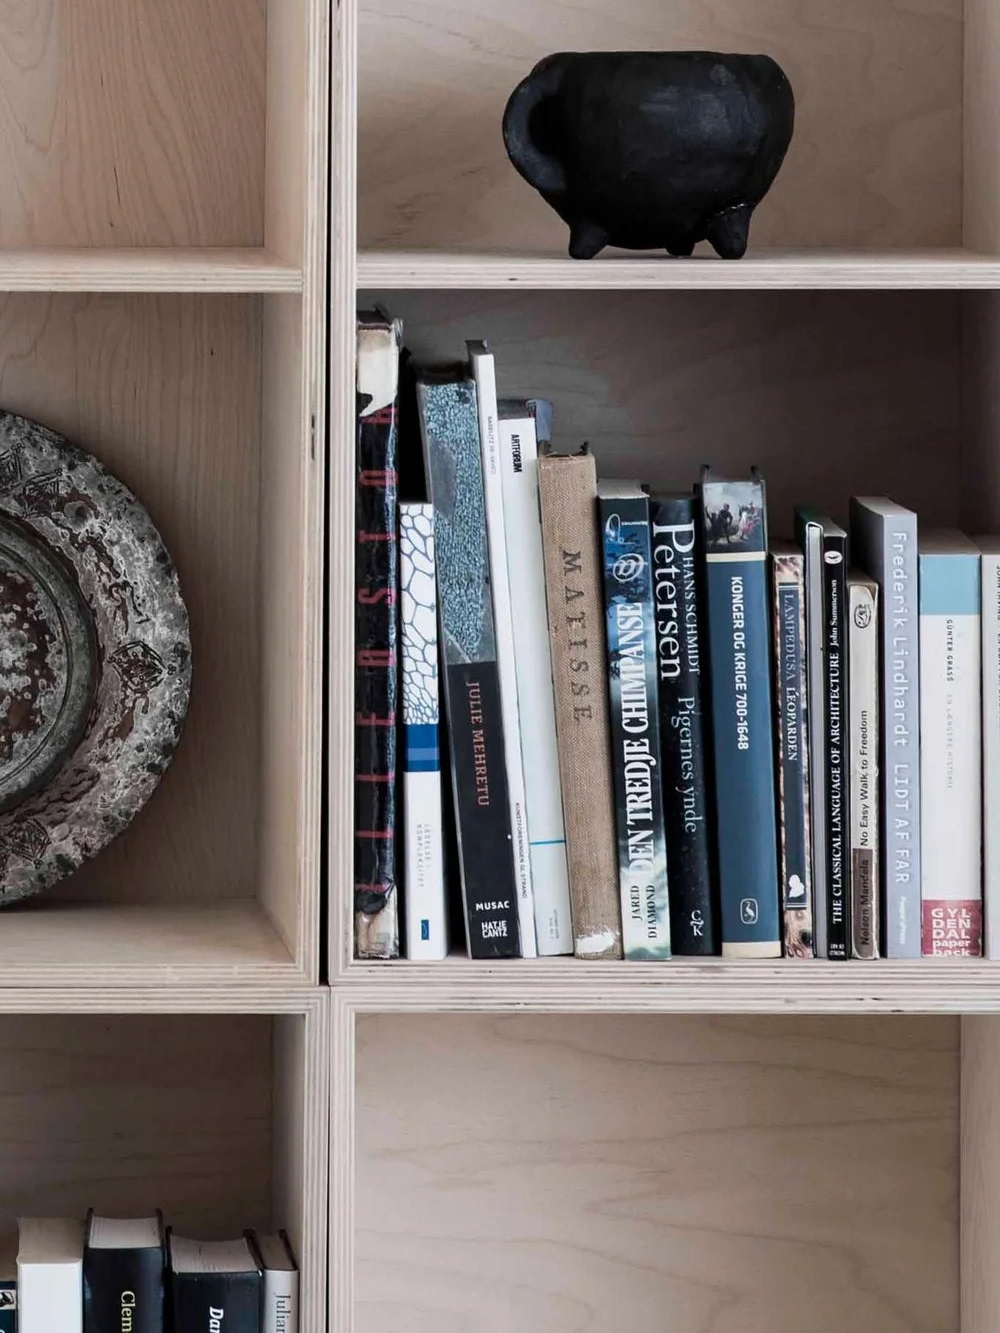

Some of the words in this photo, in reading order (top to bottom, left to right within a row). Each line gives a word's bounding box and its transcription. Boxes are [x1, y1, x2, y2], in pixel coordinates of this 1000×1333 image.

[511, 434, 522, 473] ARTFORUM
[683, 557, 696, 600] HANS
[892, 532, 908, 626] Frederik
[652, 520, 696, 680] Petersen
[731, 577, 744, 628] KONGER
[829, 579, 838, 626] Summerson
[560, 547, 593, 723] MATISSE
[685, 604, 701, 675] SCHMIDT
[733, 633, 745, 650] OG
[784, 594, 796, 681] LAMPEDUSA
[830, 628, 839, 647] John
[946, 619, 954, 651] GÜNTER
[616, 602, 649, 734] CHIMPANSE
[734, 653, 746, 690] KRIGE
[946, 655, 954, 682] GRASS
[466, 682, 483, 724] JULIE
[829, 652, 840, 743] ARCHITECTURE
[893, 636, 910, 747] Lindhardt
[671, 696, 696, 780] Pigernes
[736, 694, 749, 750] 700-1648
[859, 710, 869, 756] Freedom
[472, 729, 489, 806] MEHRETU
[831, 747, 841, 764] OF
[861, 759, 868, 770] to
[623, 738, 657, 826] TREDJE
[831, 767, 841, 827] LANGUAGE
[860, 772, 869, 801] Walk
[894, 764, 911, 810] LIDT
[675, 787, 703, 833] ynde
[860, 804, 870, 830] Easy
[895, 818, 910, 841] AF
[628, 828, 655, 871] DEN
[861, 831, 869, 846] No
[832, 830, 842, 898] CLASSICAL
[861, 859, 869, 907] Mandela
[895, 849, 911, 883] FAR
[476, 900, 510, 911] MUSAC
[631, 885, 643, 921] JARED
[646, 885, 658, 939] DIAMOND
[833, 901, 842, 924] THE
[931, 907, 972, 918] GYL
[932, 918, 971, 928] DEN
[481, 920, 507, 930] HATJE
[482, 929, 508, 938] CANTZ
[861, 909, 869, 945] Nelson
[932, 929, 970, 938] DAL
[932, 939, 970, 948] paper
